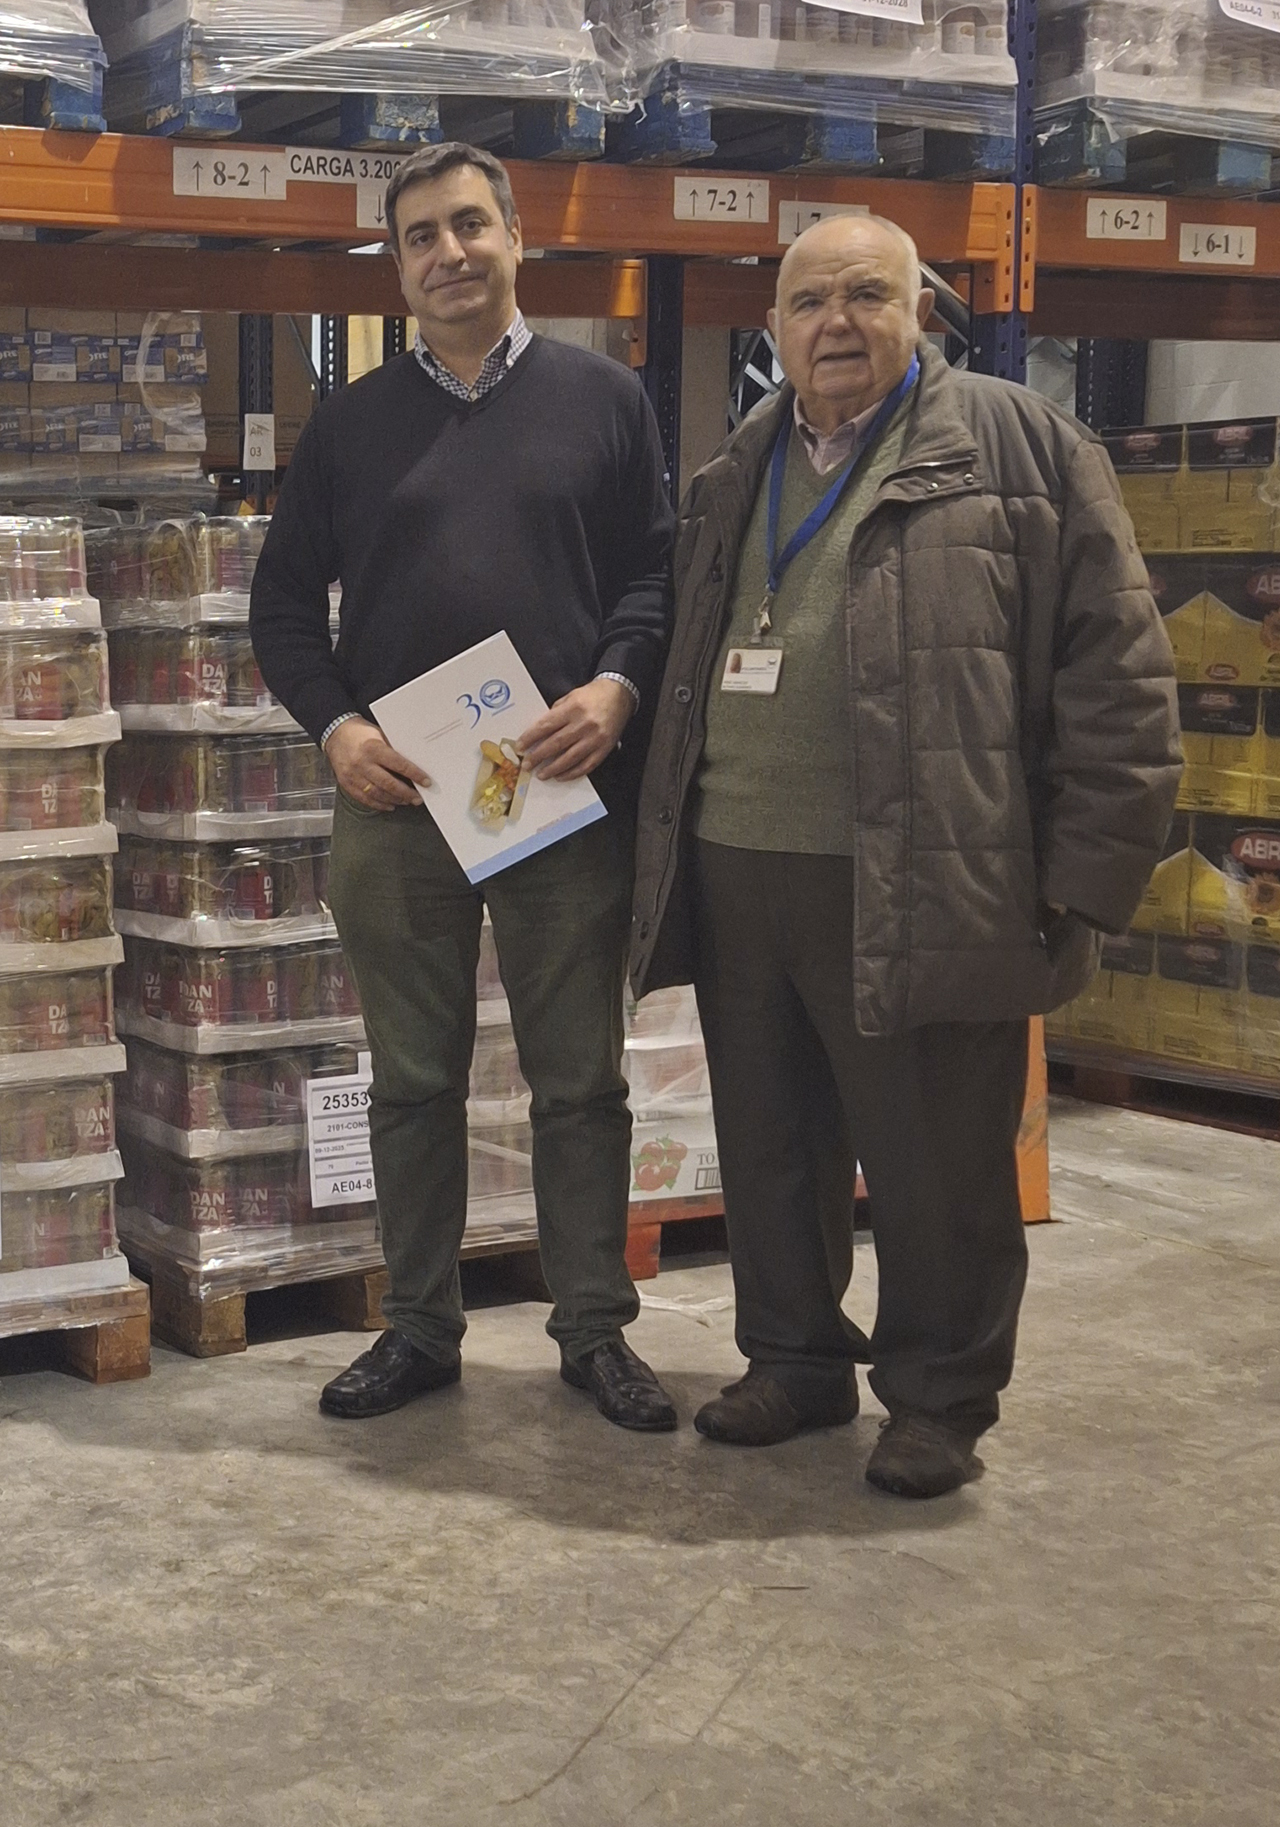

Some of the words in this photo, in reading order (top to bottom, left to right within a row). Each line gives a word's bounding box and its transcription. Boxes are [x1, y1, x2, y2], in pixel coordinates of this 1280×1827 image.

[212, 160, 250, 187] 8-2
[290, 153, 355, 178] CARGA
[706, 188, 738, 212] 7-2
[1113, 208, 1140, 231] 6-2
[1205, 232, 1231, 254] 6-1
[249, 446, 263, 457] 03
